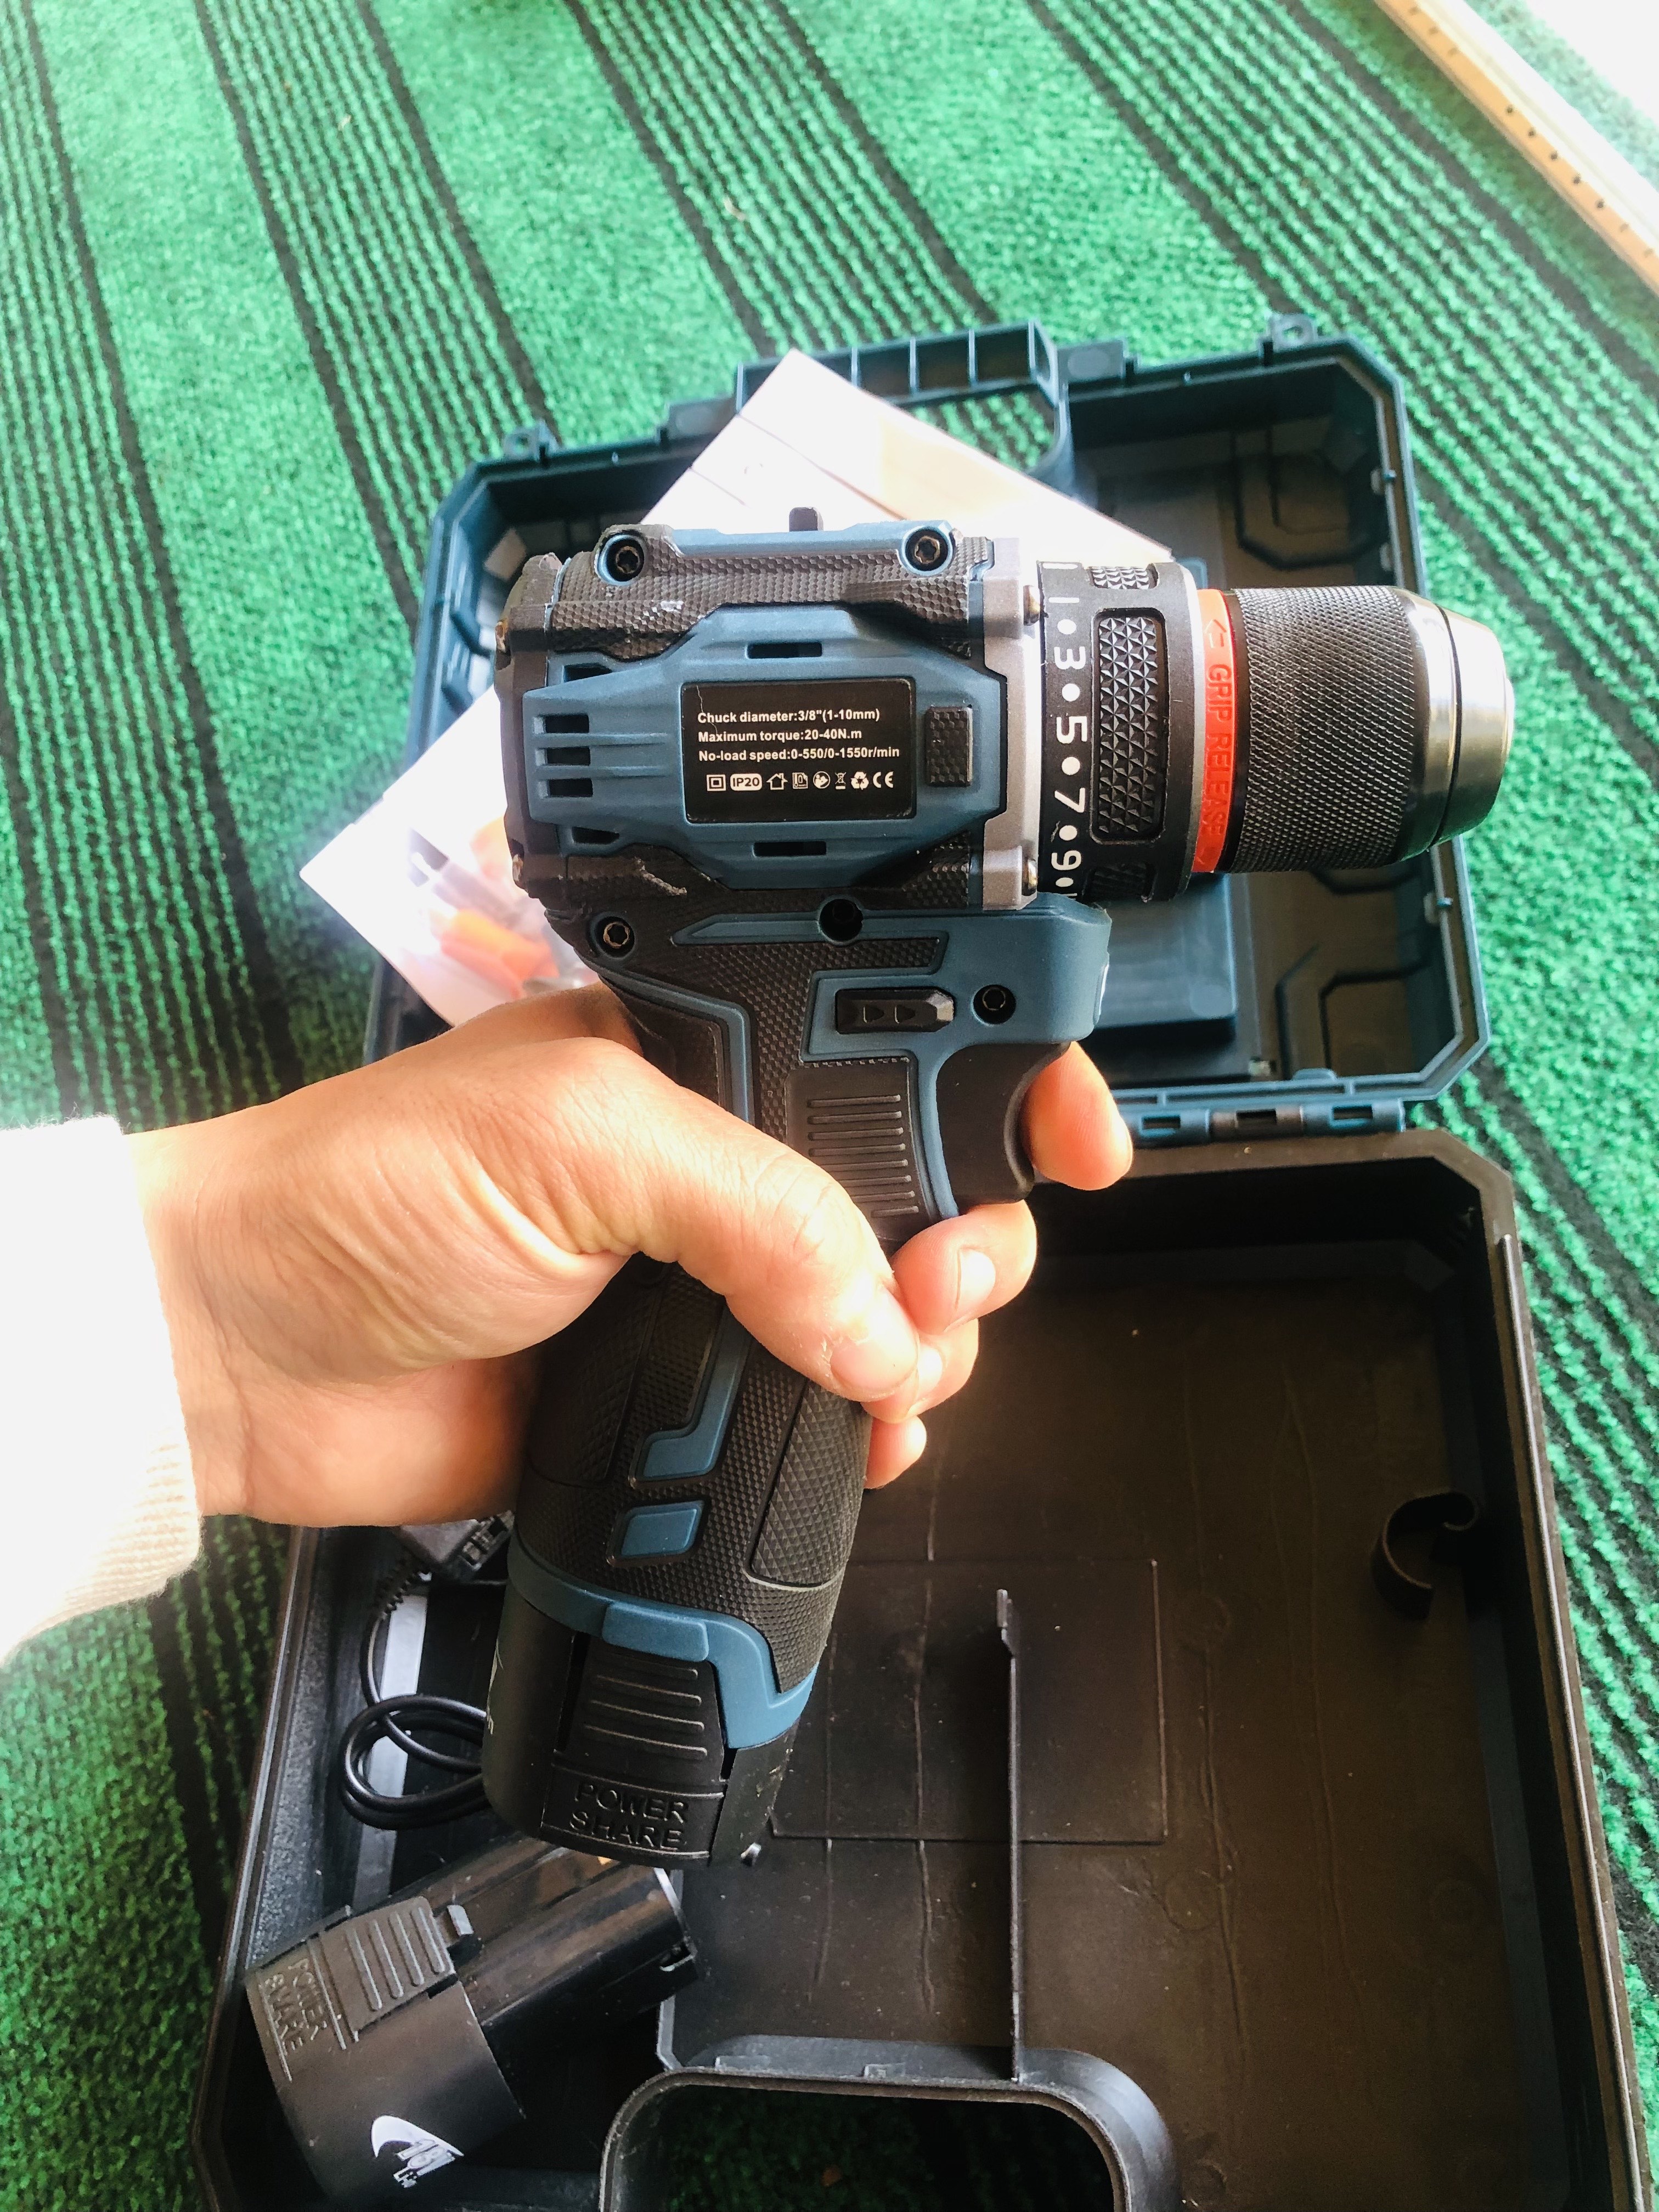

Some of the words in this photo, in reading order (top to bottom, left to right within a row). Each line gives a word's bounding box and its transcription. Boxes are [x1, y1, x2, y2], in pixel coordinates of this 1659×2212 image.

[1053, 646, 1086, 670] 3
[1207, 663, 1233, 723] GRIP
[697, 712, 737, 724] Chuck
[739, 708, 880, 723] diameter:3/8"(1-10mm)
[698, 730, 757, 742] Maximum
[759, 729, 862, 743] torque:20-40N.m
[1056, 715, 1088, 744] 5
[699, 749, 747, 761] No-load
[749, 746, 900, 763] speed:0-550/0-1550r/min
[732, 777, 760, 787] IP20
[1201, 732, 1233, 836] RELEASE
[1054, 787, 1086, 814] 7
[1051, 850, 1082, 871] 9
[574, 1782, 690, 1826] POWER
[569, 1810, 688, 1853] SHARE
